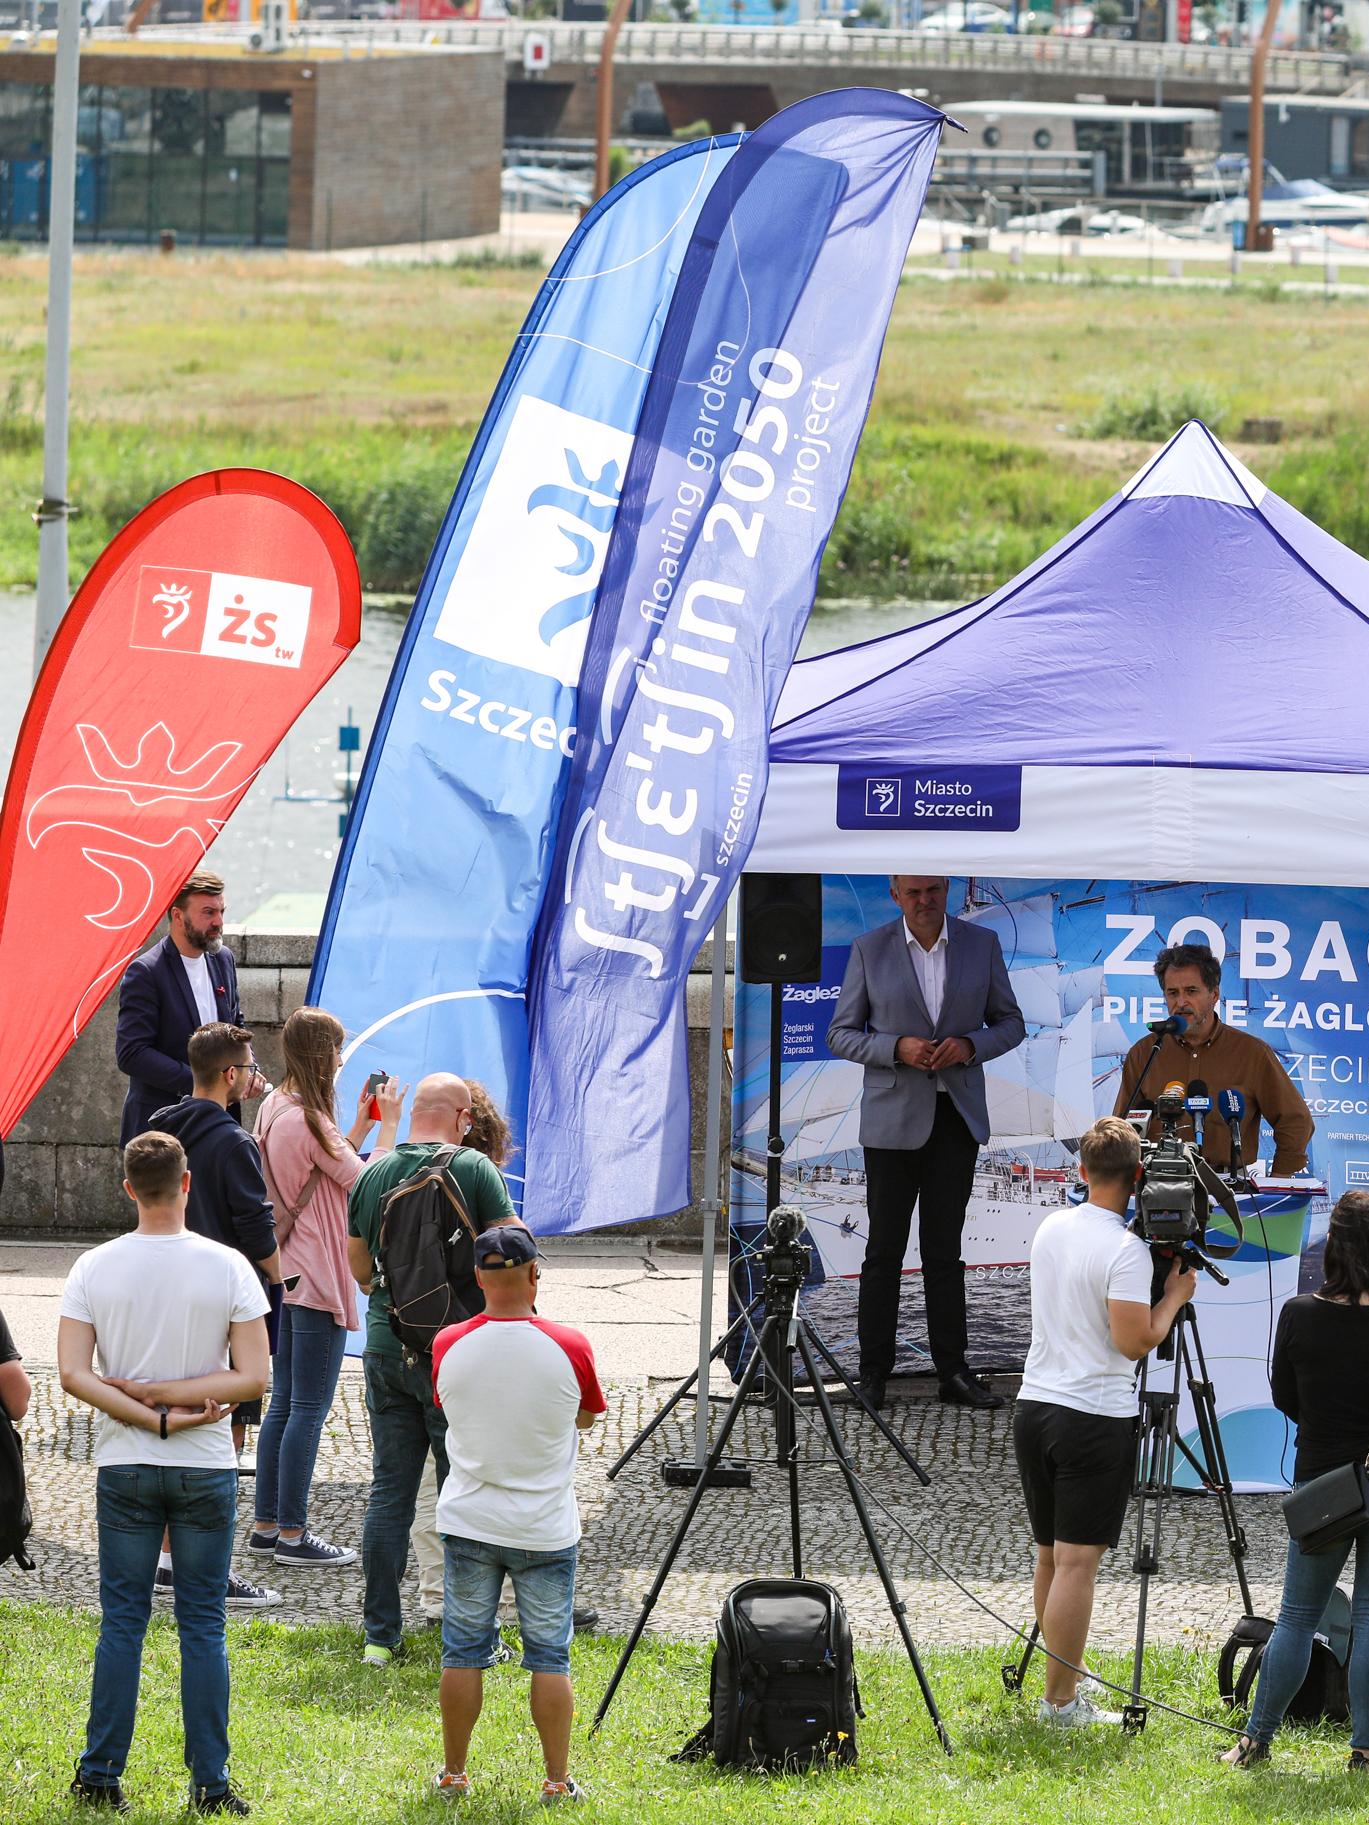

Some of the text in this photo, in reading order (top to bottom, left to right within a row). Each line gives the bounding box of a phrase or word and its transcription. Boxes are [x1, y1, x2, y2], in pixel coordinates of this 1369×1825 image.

[702, 347, 803, 558] 2050
[785, 376, 840, 512] project
[640, 340, 740, 624] floating garden
[420, 669, 577, 758] Szczec
[914, 780, 972, 796] Miasto
[914, 800, 993, 817] Szczecin
[716, 772, 753, 866] szczecin
[783, 984, 841, 1004] Żagle2
[783, 1023, 814, 1035] Żeglarski
[783, 1034, 813, 1044] Szczecin
[783, 1045, 814, 1055] Zaprasza
[1328, 1132, 1354, 1141] PARTNER
